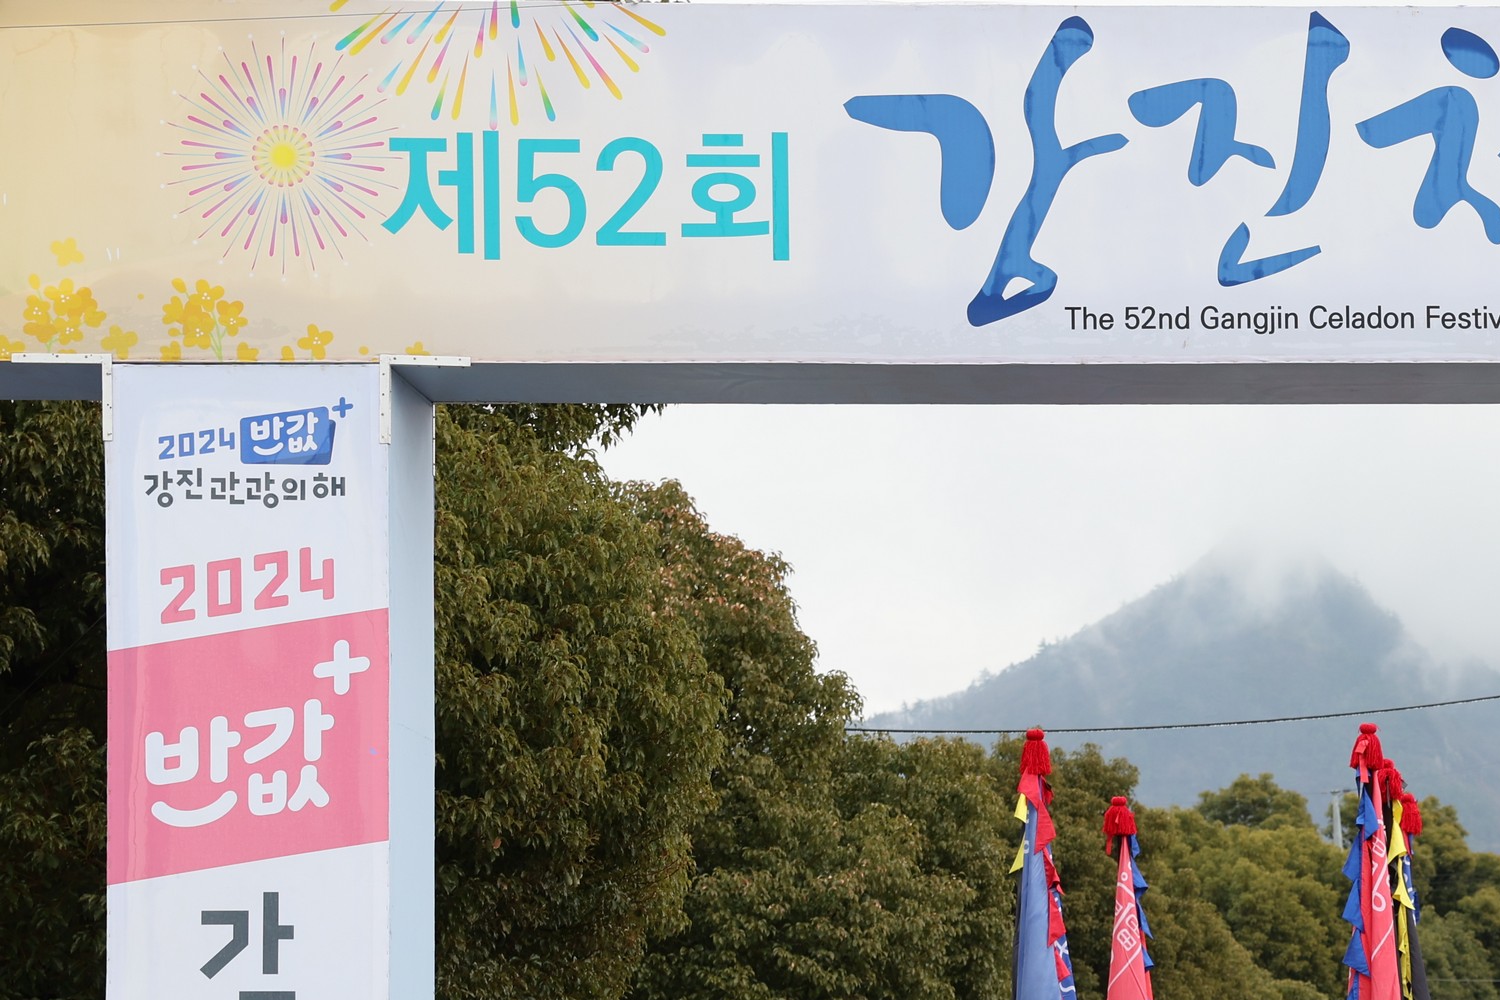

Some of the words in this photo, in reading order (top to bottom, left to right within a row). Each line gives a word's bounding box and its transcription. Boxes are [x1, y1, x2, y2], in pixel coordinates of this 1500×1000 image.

[381, 130, 790, 261] 제52회
[1065, 306, 1114, 331] The
[1124, 305, 1190, 331] 52nd
[1200, 305, 1299, 337] Gangjin
[1309, 305, 1416, 331] Celadon
[158, 427, 235, 460] 2024
[160, 547, 334, 624] 2024
